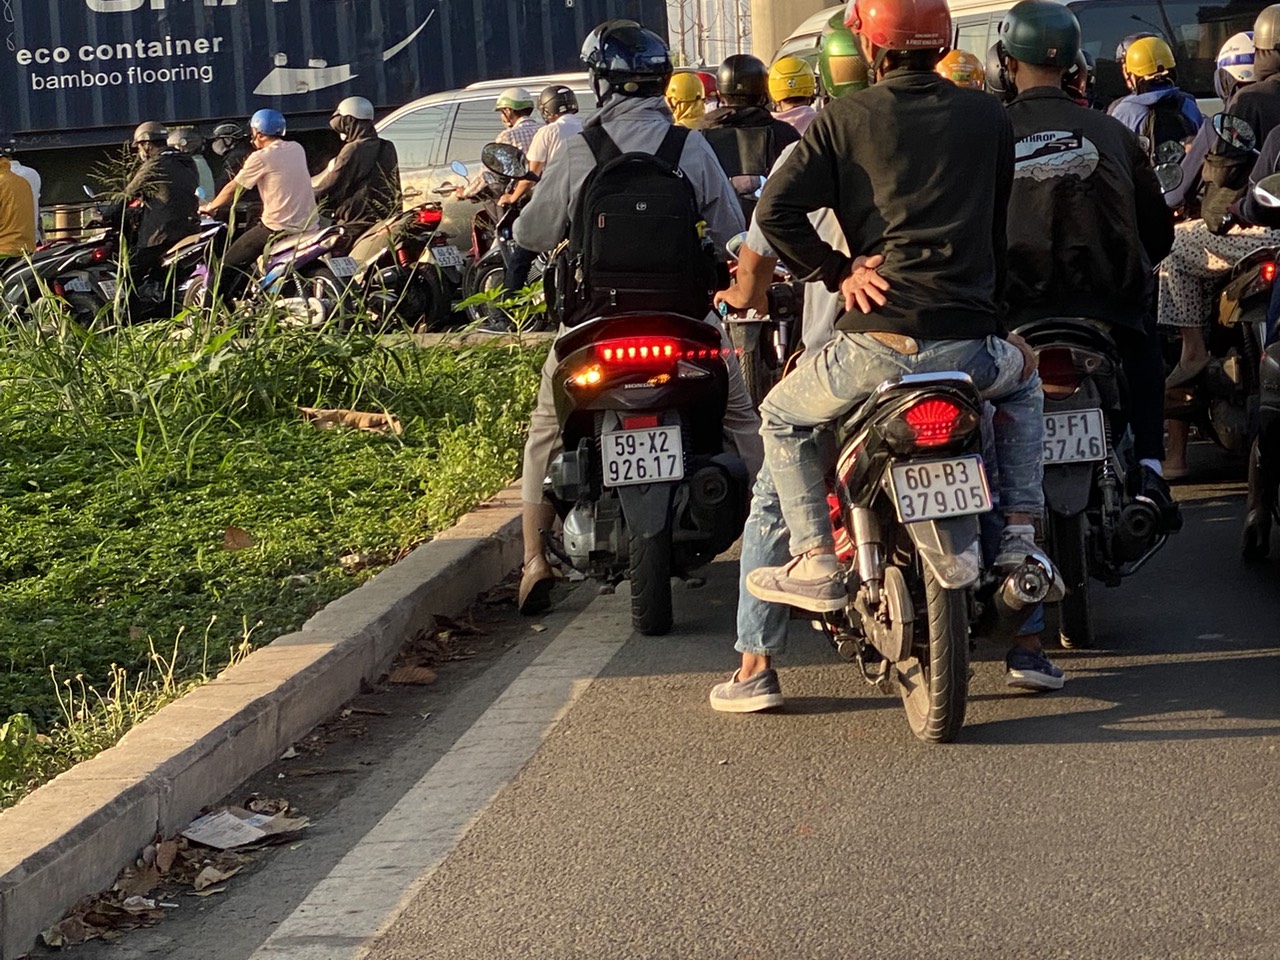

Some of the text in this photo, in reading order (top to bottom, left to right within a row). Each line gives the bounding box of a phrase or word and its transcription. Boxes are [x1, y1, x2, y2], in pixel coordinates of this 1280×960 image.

[16, 35, 223, 66] eco container
[31, 63, 214, 90] bamboo flooring
[1045, 414, 1089, 437] 9-F1
[614, 431, 669, 456] 59-X2
[1043, 436, 1101, 460] 57.46
[609, 455, 677, 481] 926.17
[905, 462, 969, 490] 60-B3
[901, 486, 984, 518] 379.05
